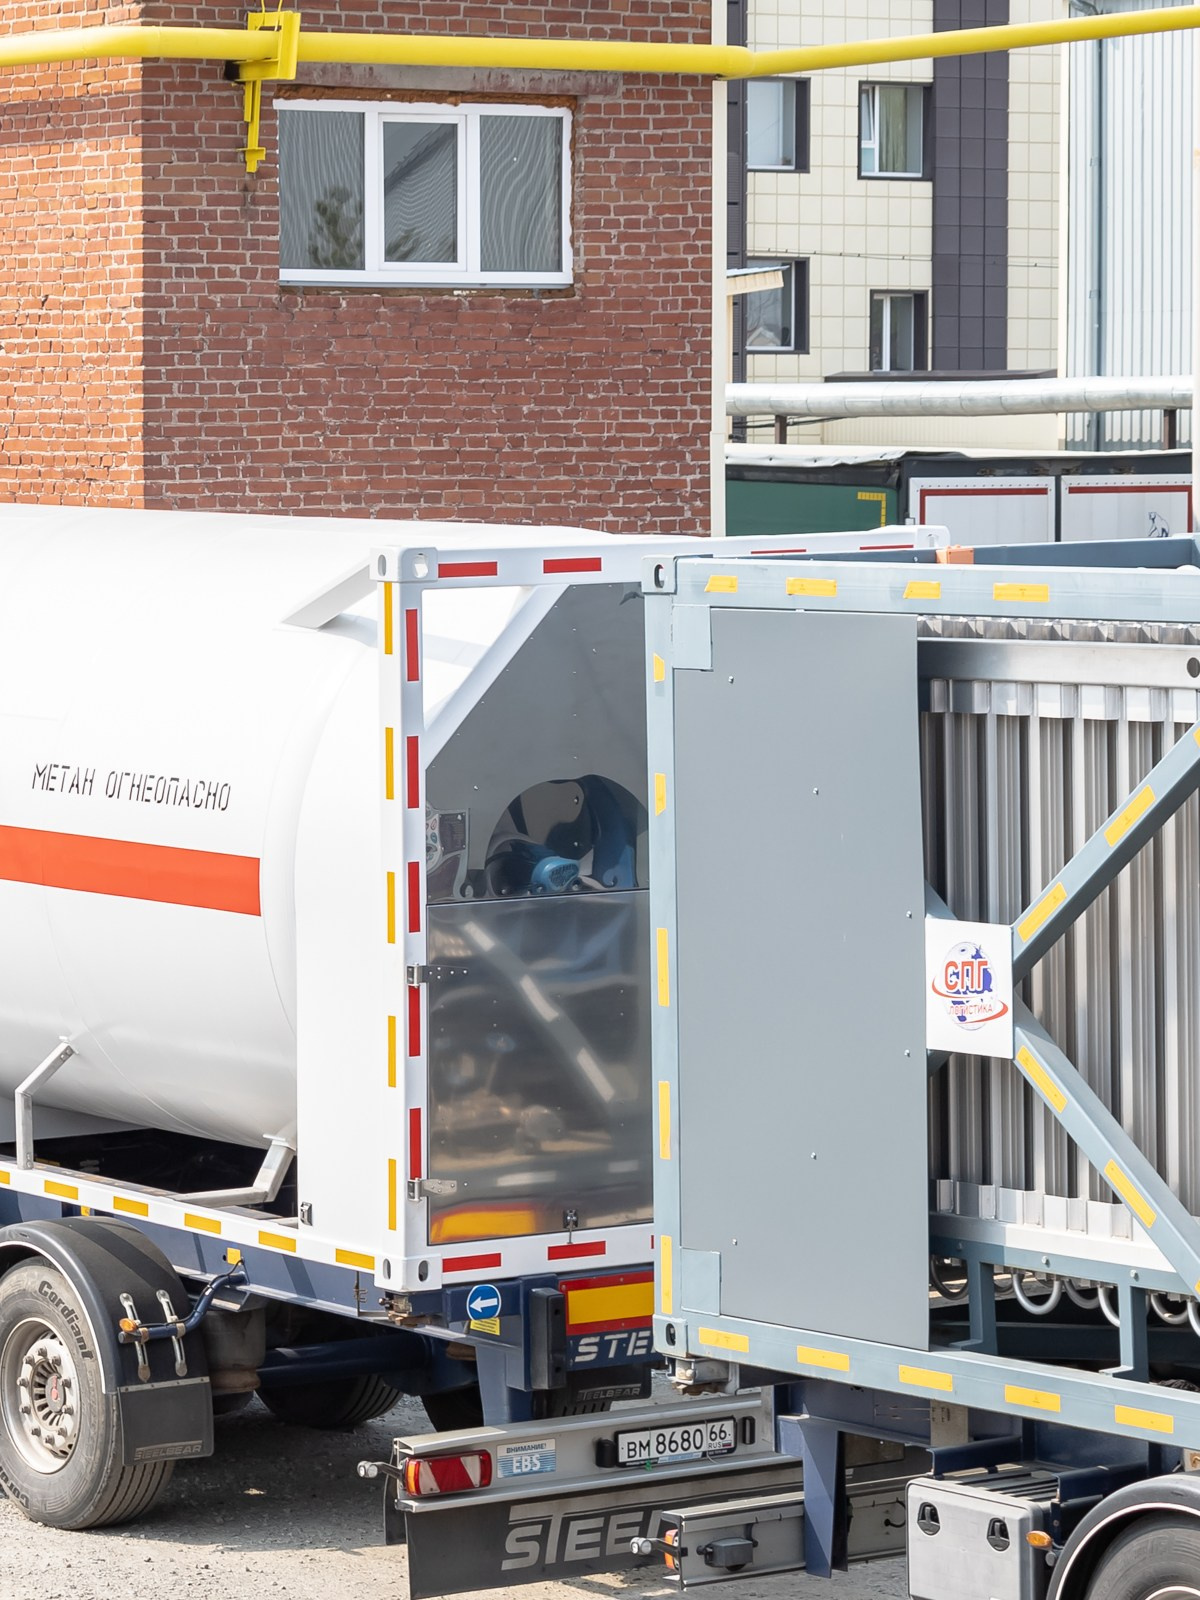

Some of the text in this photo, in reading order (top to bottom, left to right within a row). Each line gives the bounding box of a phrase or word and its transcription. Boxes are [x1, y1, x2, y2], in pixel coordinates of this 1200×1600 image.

[32, 762, 232, 812] МЕТАН ОГНЕОПАСНО
[944, 960, 988, 991] СПГ
[948, 1003, 994, 1017] ЛОГИСТИКА
[38, 1280, 94, 1360] Cordiant
[575, 1329, 656, 1363] STE
[577, 1383, 641, 1402] STEELBEAR
[133, 1439, 203, 1461] STEELBEAR
[506, 1442, 547, 1455] ВНИМАНИЕ!
[656, 1428, 704, 1455] 8680
[709, 1423, 728, 1442] 66
[707, 1441, 722, 1449] RUS
[512, 1454, 542, 1474] EBS
